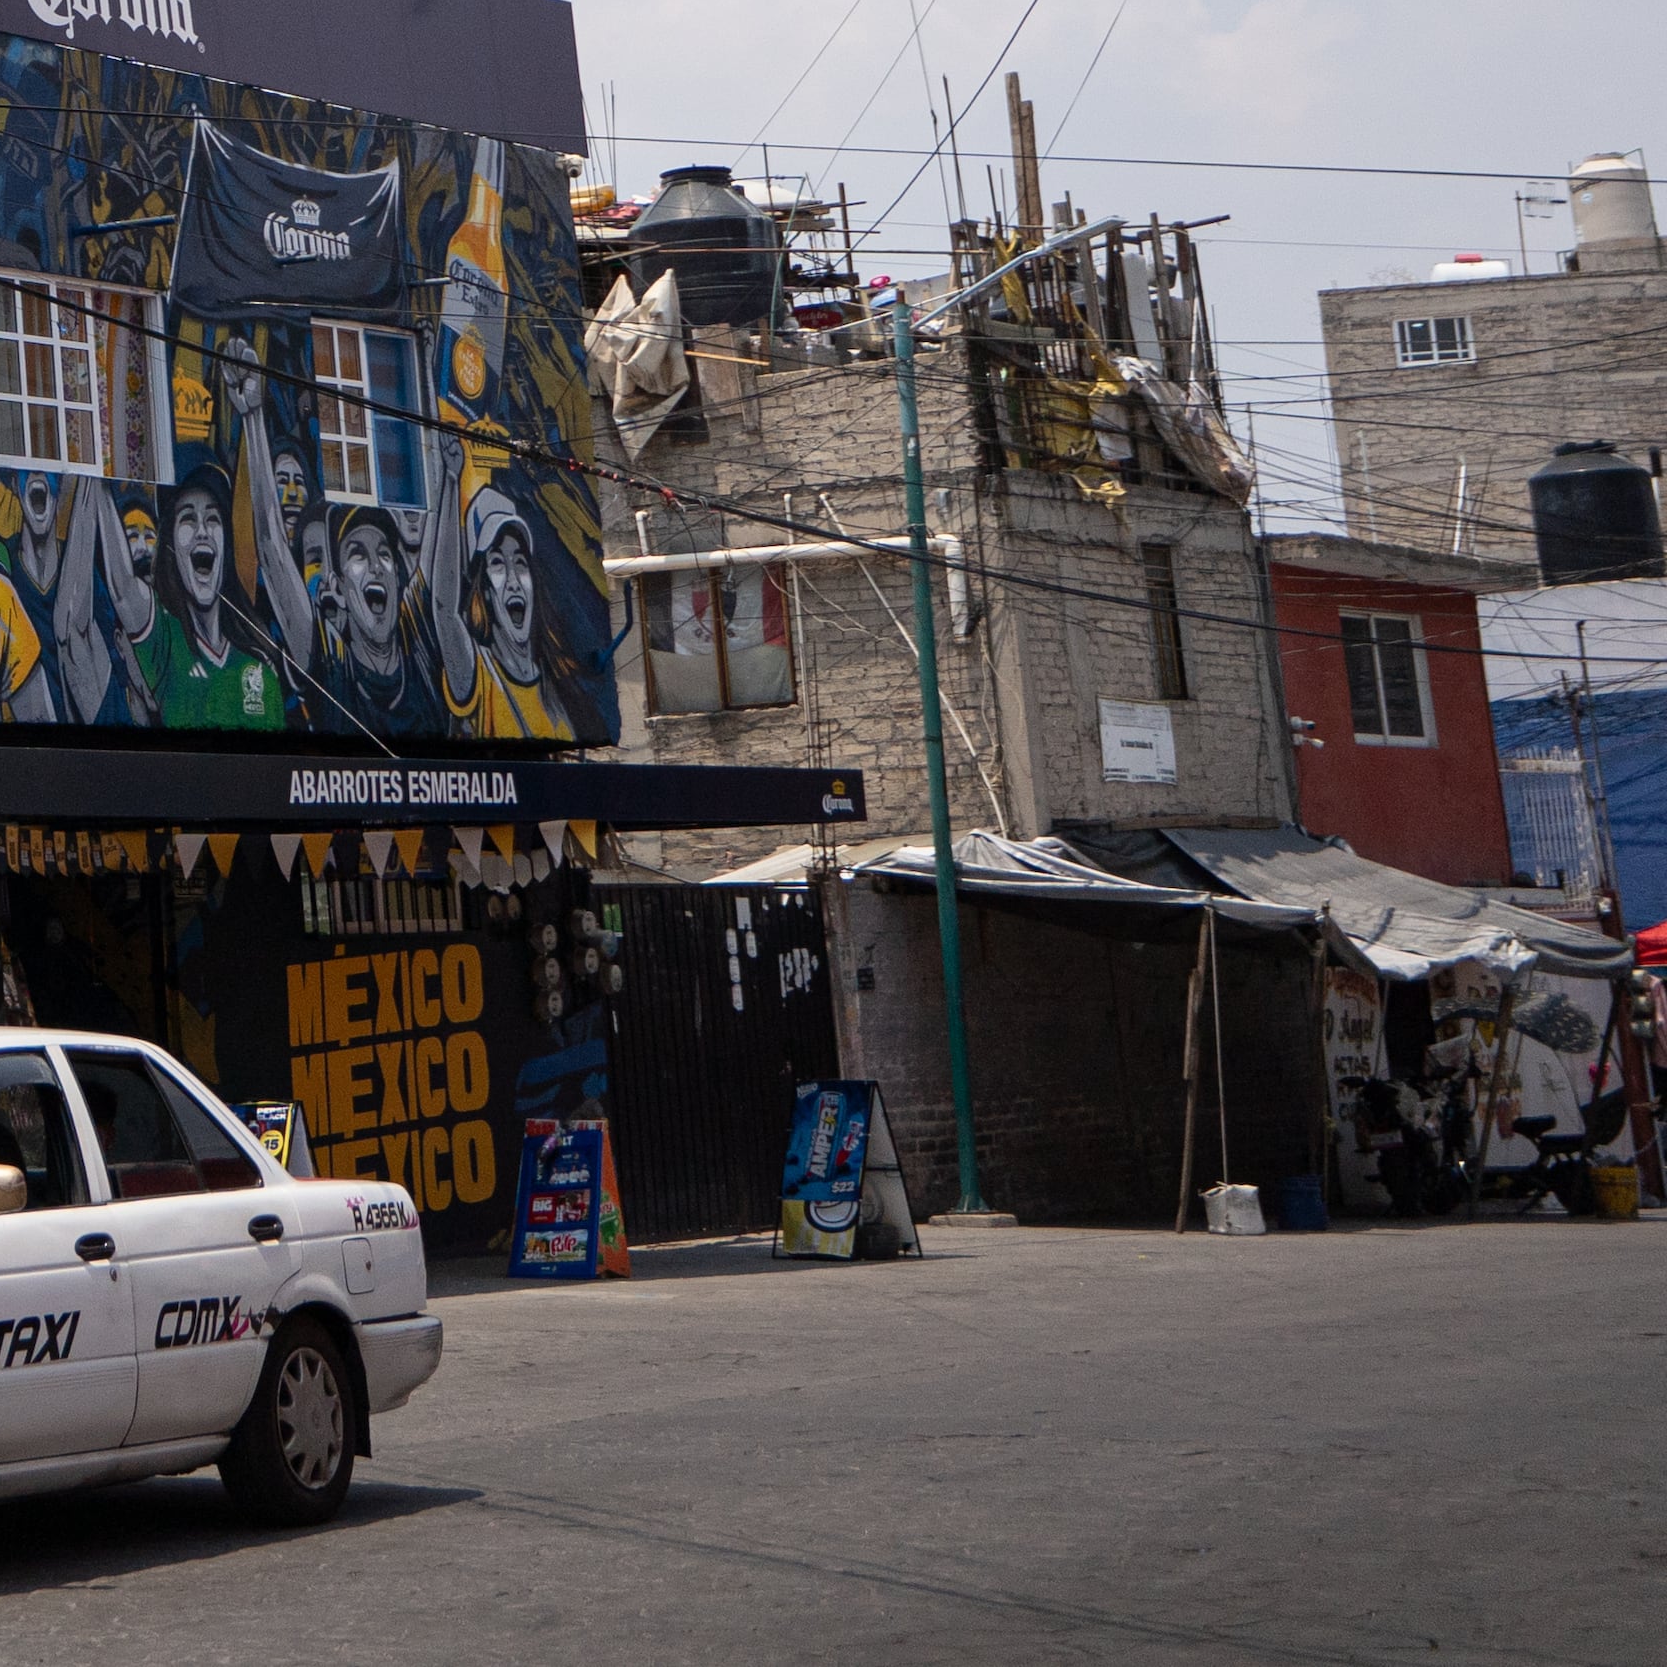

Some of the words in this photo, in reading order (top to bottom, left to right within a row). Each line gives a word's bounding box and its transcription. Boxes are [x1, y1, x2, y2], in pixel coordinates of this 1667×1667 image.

[263, 211, 353, 261] Corona
[289, 769, 403, 804] ABARROTES
[408, 770, 517, 805] ESMERALDA
[821, 793, 854, 814] Corona
[286, 943, 484, 1048] MÉXICO
[290, 1031, 491, 1142] MÉXICO
[264, 1138, 280, 1151] 15
[532, 1199, 553, 1212] BIG
[154, 1295, 242, 1351] CDMX
